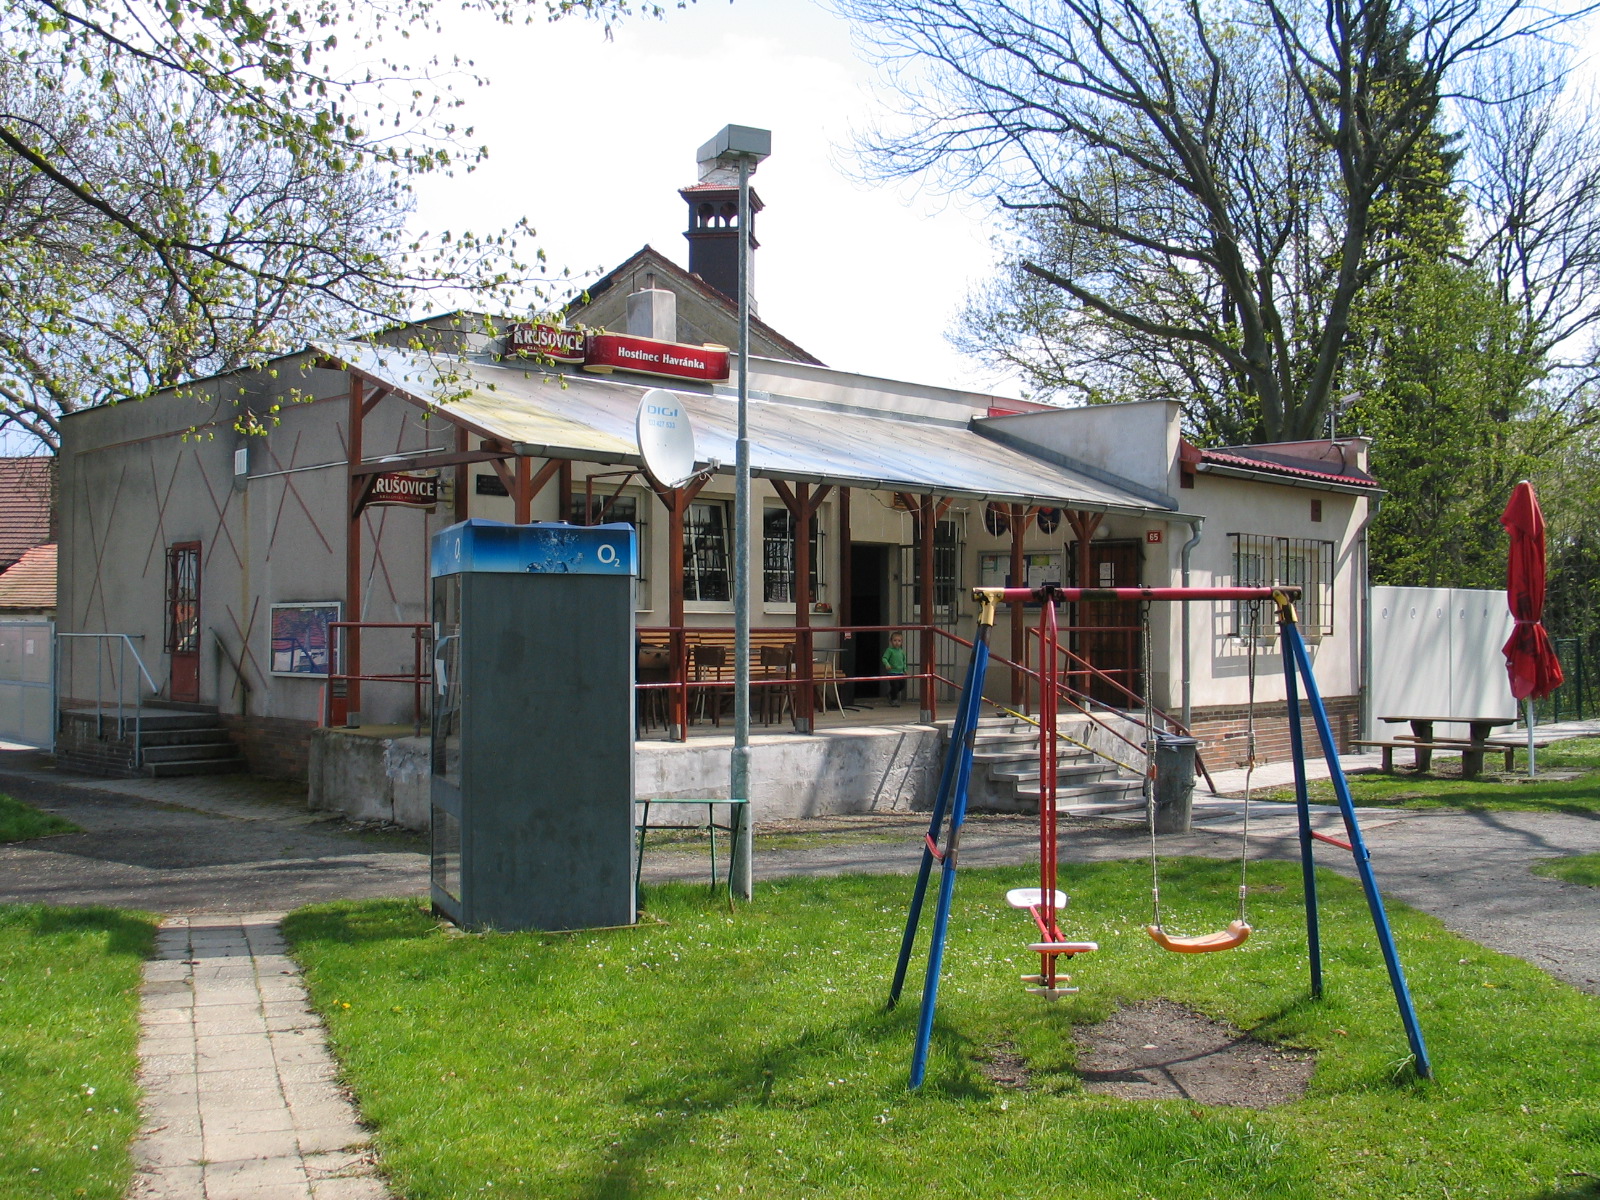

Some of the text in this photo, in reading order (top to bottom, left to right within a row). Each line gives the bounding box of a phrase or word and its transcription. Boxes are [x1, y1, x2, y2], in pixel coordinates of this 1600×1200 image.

[513, 324, 584, 351] KRUŠOVICE
[618, 346, 705, 370] Hostinec Havránka
[647, 405, 679, 417] DIGI
[372, 476, 435, 497] RUŠOVICE
[1149, 533, 1159, 541] 65
[597, 544, 620, 568] O2
